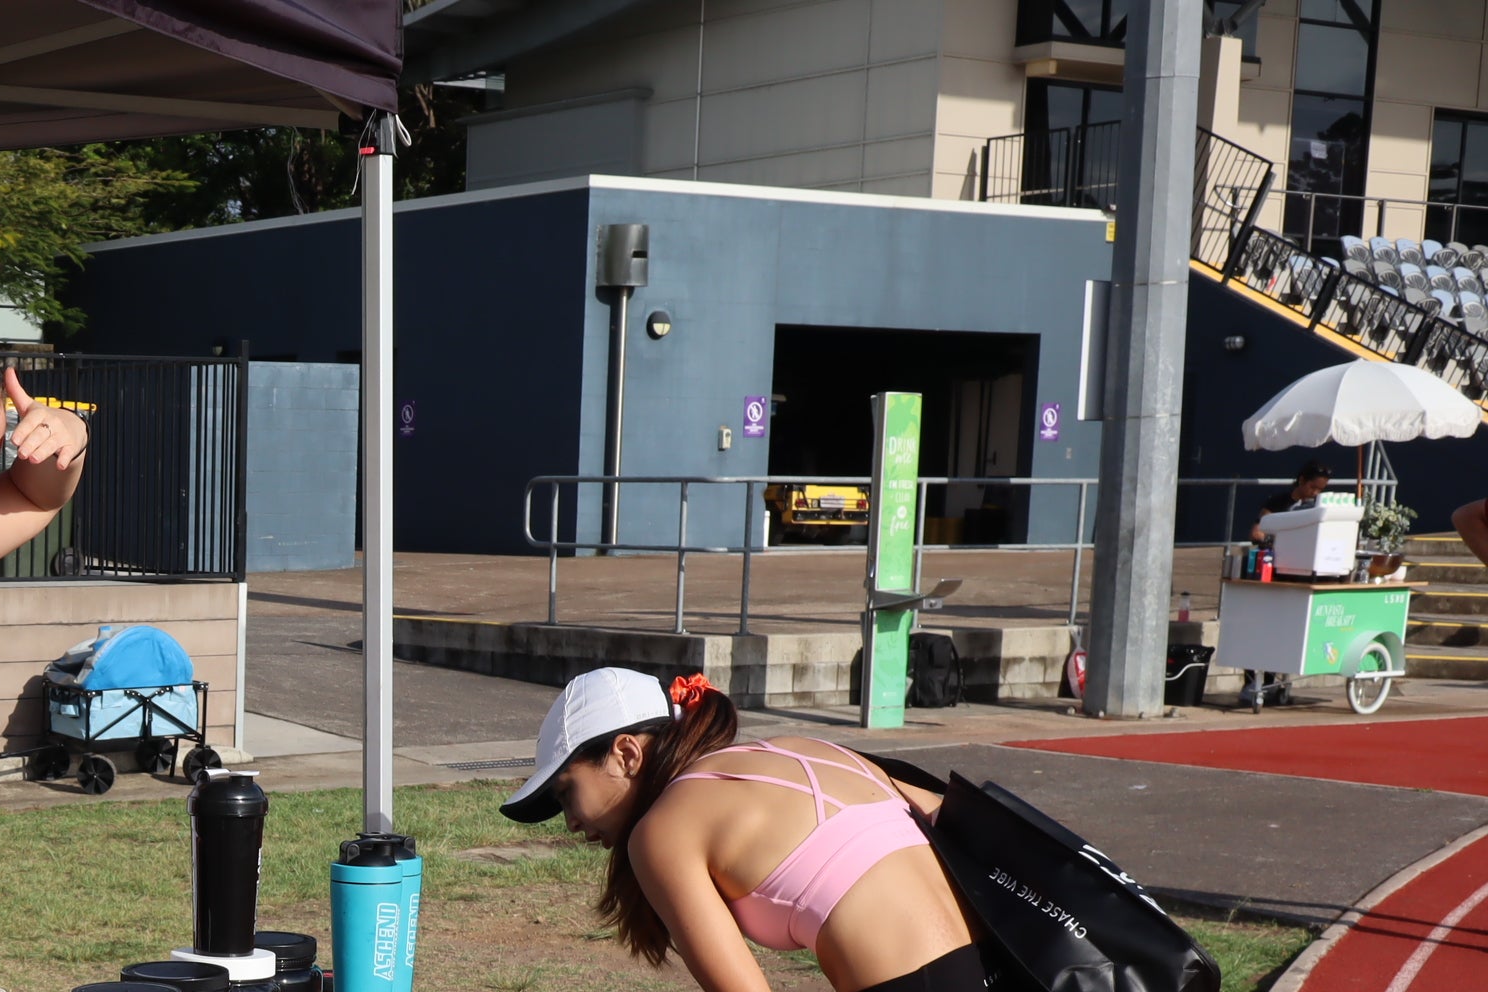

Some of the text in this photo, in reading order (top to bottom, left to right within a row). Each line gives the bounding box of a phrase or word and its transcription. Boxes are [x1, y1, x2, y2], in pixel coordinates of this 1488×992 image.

[988, 867, 1087, 939] CHASE THE VIBE
[374, 902, 398, 980] ASCEND
